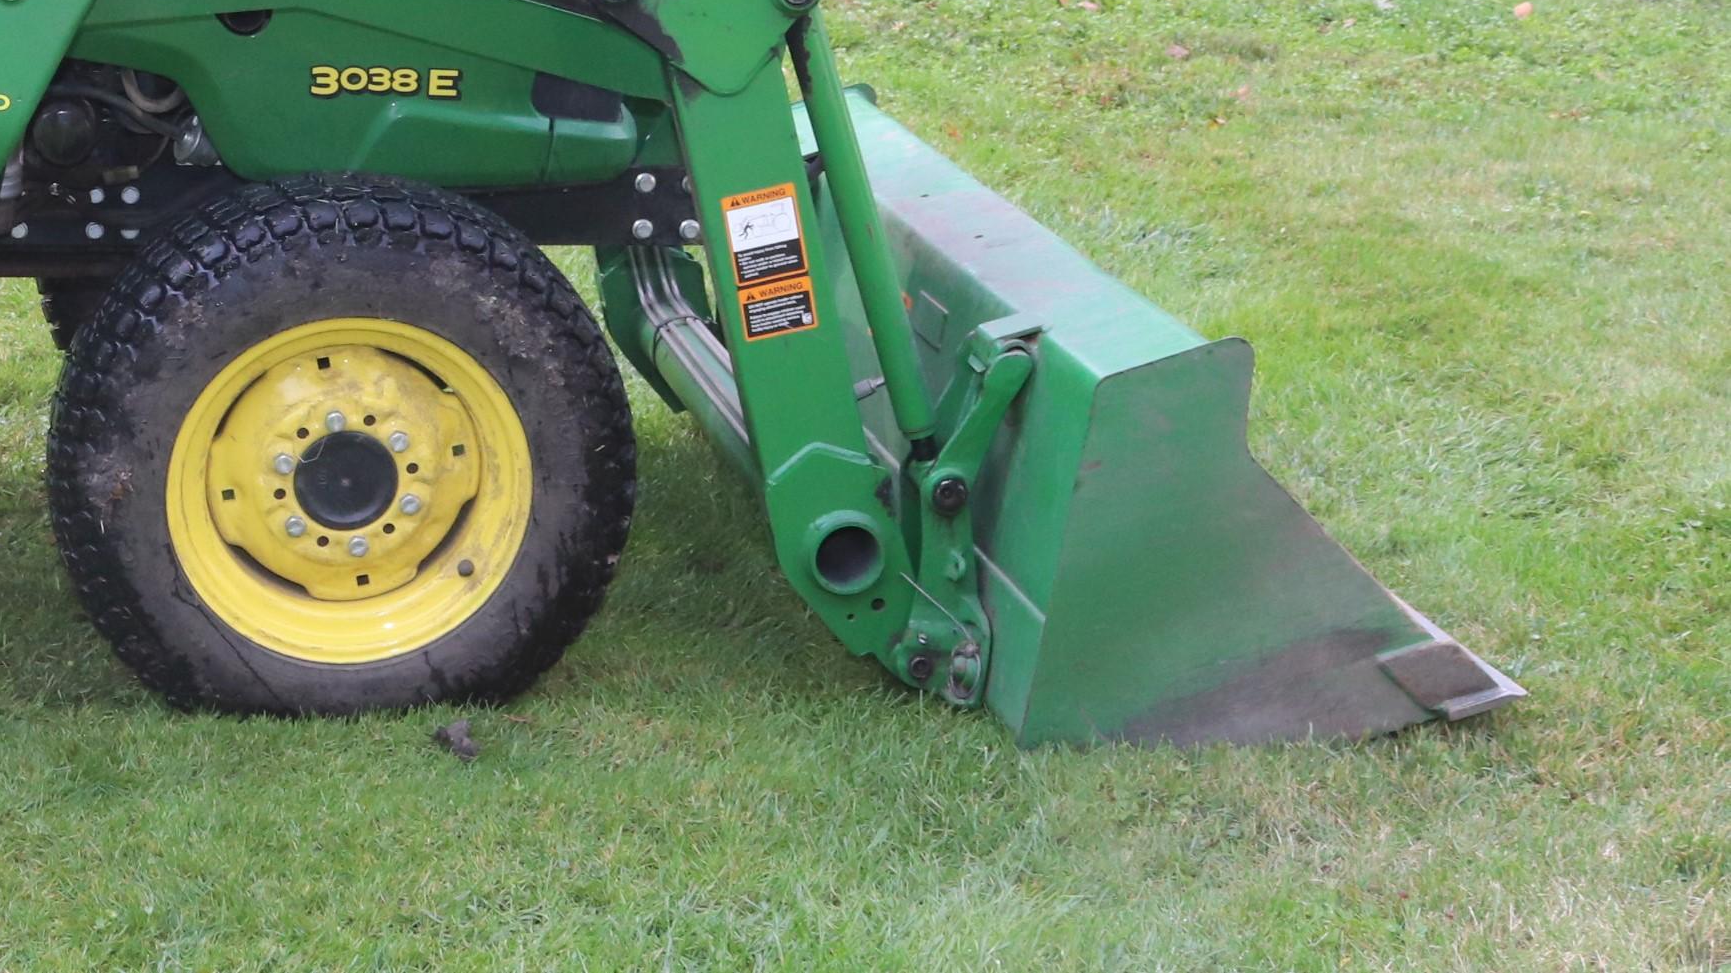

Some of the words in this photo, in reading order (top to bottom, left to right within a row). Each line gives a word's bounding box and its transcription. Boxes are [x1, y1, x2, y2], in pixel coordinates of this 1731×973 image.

[310, 66, 419, 96] 3038
[428, 69, 459, 97] E
[741, 187, 786, 204] WARNING
[759, 281, 804, 297] WARNING
